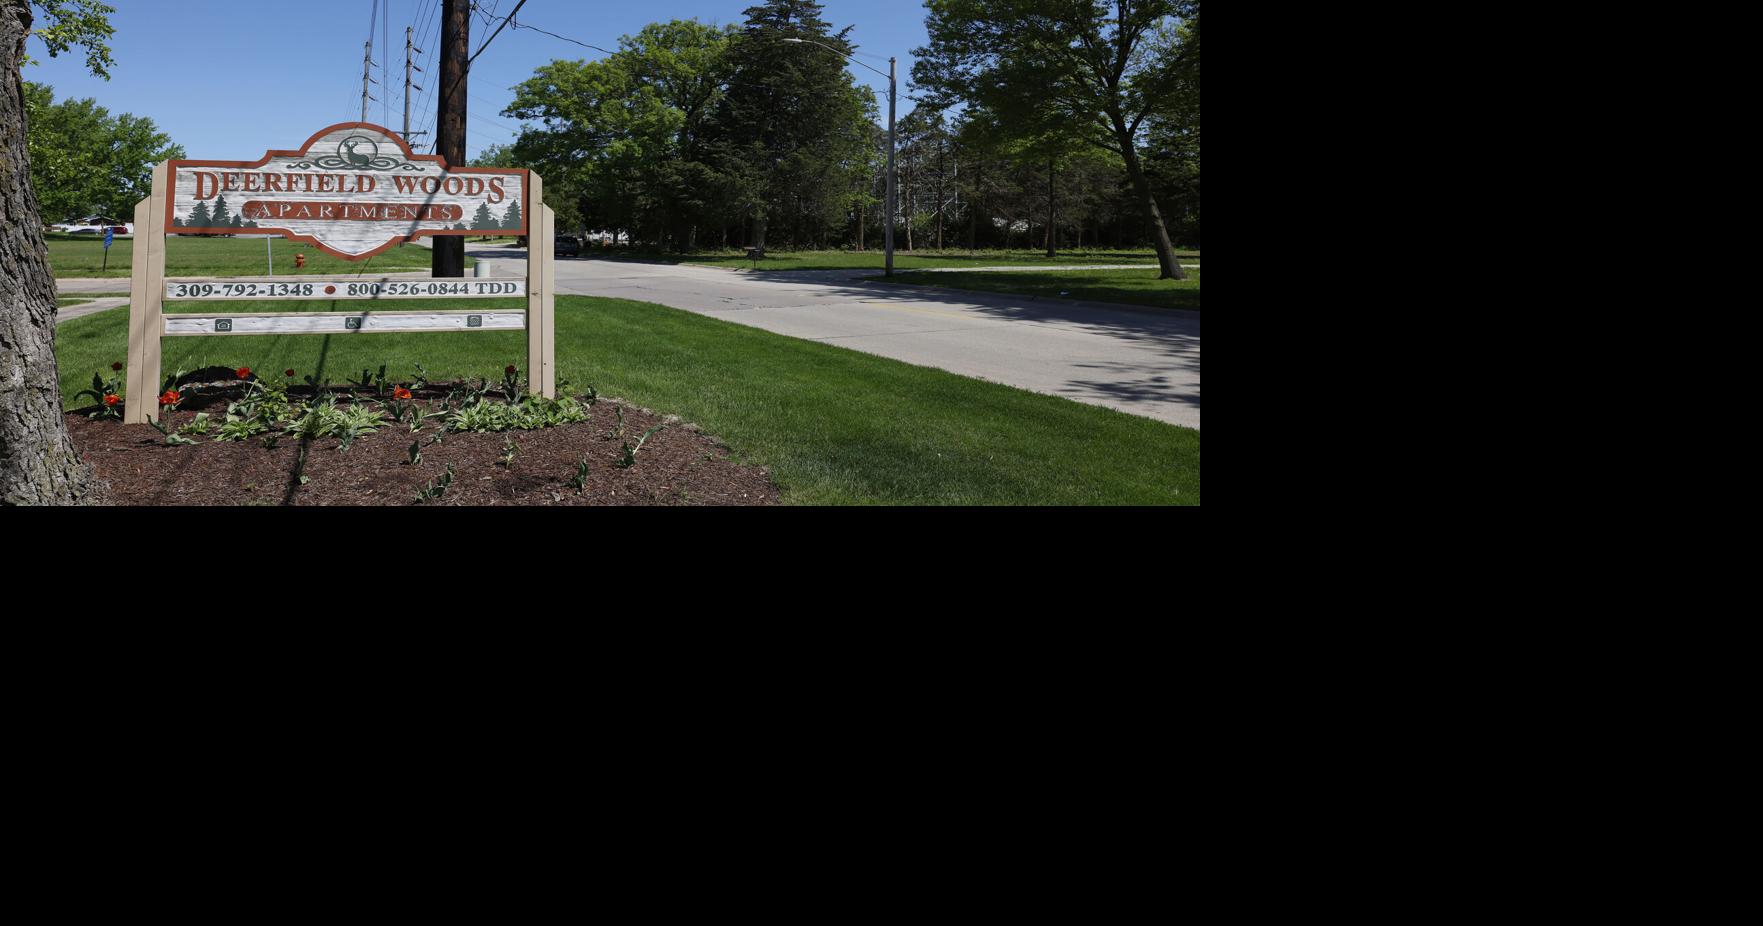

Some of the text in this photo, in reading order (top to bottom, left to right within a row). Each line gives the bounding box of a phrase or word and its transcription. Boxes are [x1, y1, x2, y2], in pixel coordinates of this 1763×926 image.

[193, 172, 505, 204] DEERFIELD WOODS
[255, 203, 453, 220] APARTMENTS
[176, 281, 518, 297] 309-792-1348 800-526-0844 TDD
